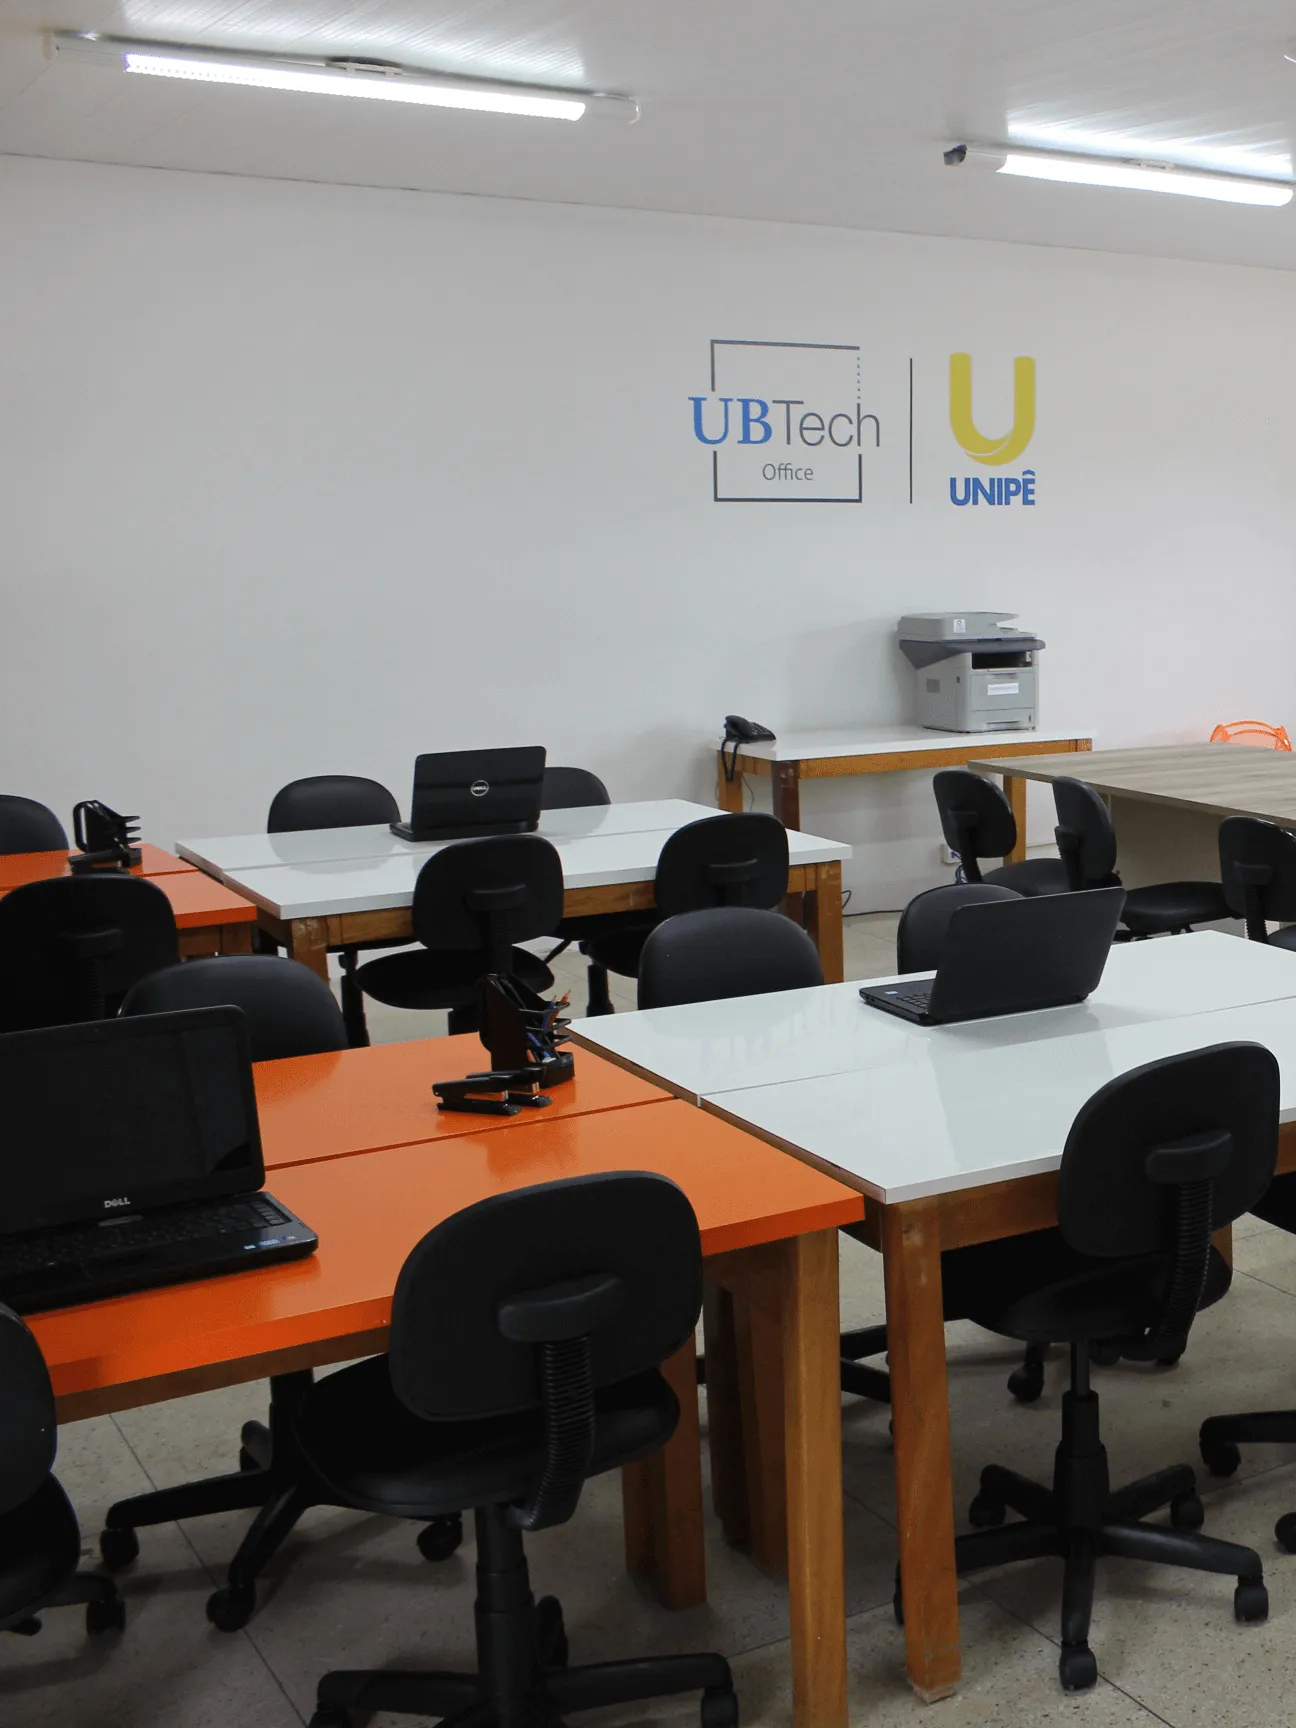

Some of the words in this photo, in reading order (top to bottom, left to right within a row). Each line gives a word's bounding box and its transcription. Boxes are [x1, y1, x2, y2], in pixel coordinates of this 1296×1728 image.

[687, 396, 880, 447] UBTech
[762, 462, 814, 481] Office
[949, 469, 1036, 507] UNIPÊ
[104, 1197, 131, 1209] DELL
